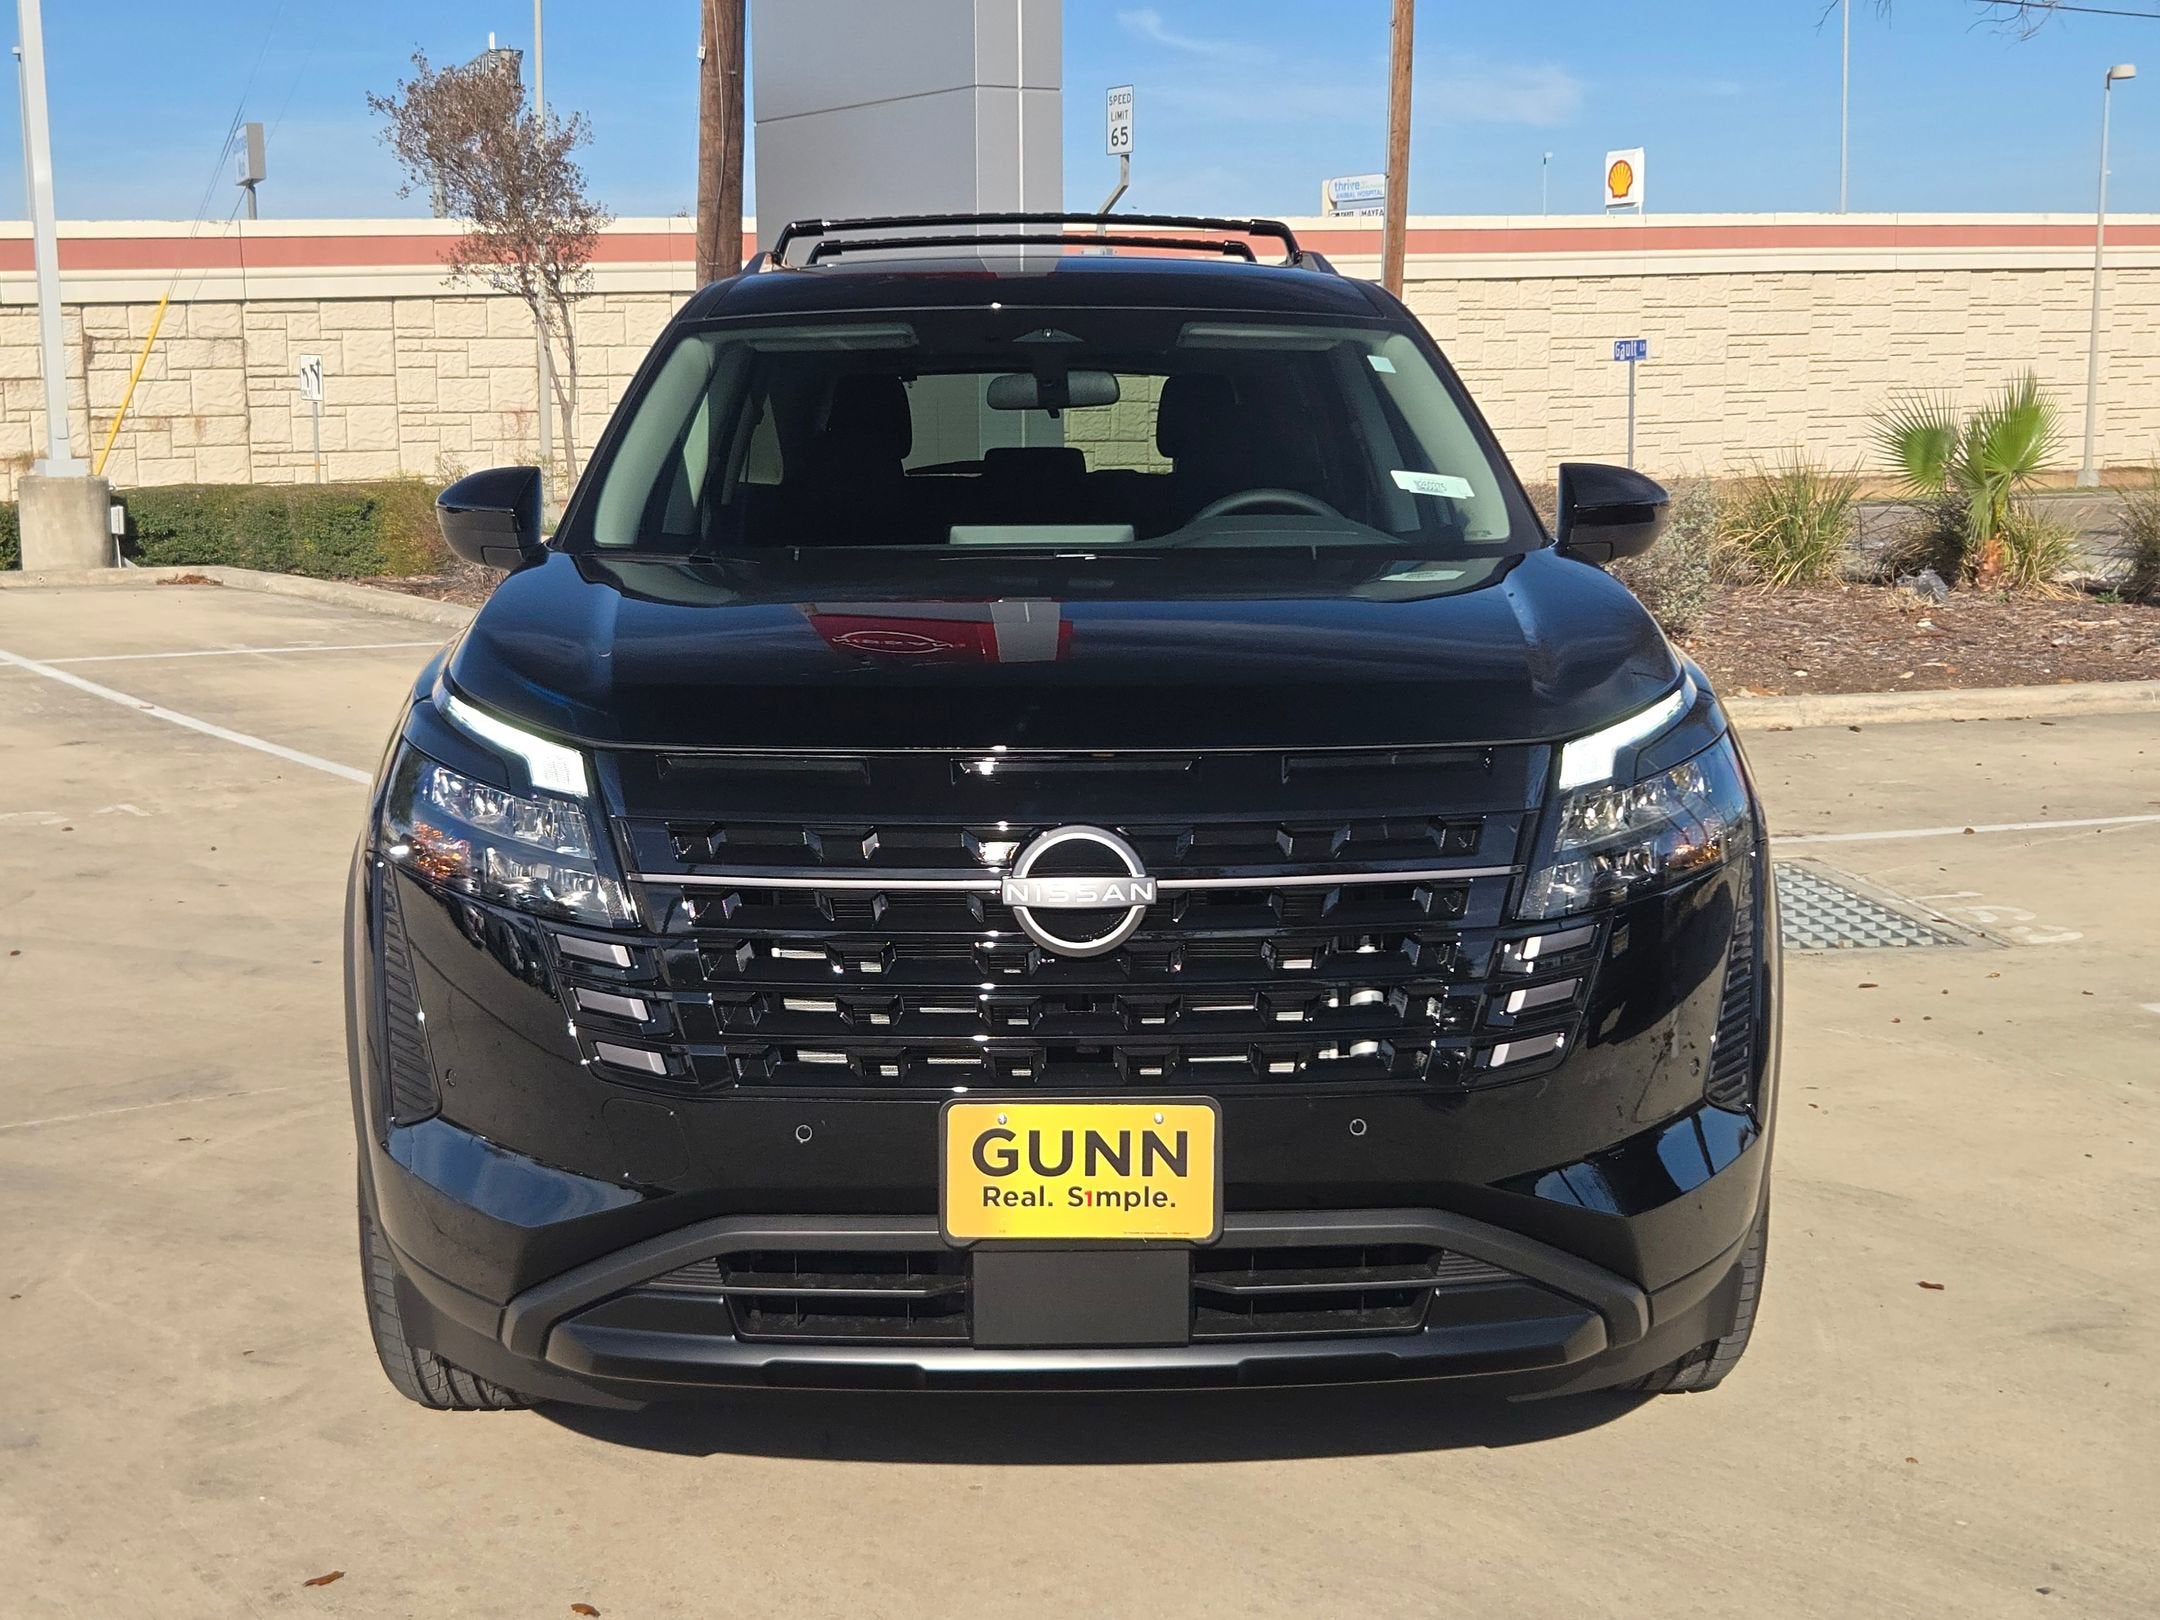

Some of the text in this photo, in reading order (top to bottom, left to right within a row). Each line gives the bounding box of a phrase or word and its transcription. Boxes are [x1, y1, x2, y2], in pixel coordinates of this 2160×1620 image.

[1109, 93, 1131, 106] SPEED
[1111, 109, 1129, 122] LIMIT
[1111, 126, 1129, 147] 65
[1334, 181, 1361, 192] thrive
[1006, 882, 1153, 903] NISSAN
[972, 1127, 1188, 1178] GUNN
[983, 1185, 1053, 1207] Real.
